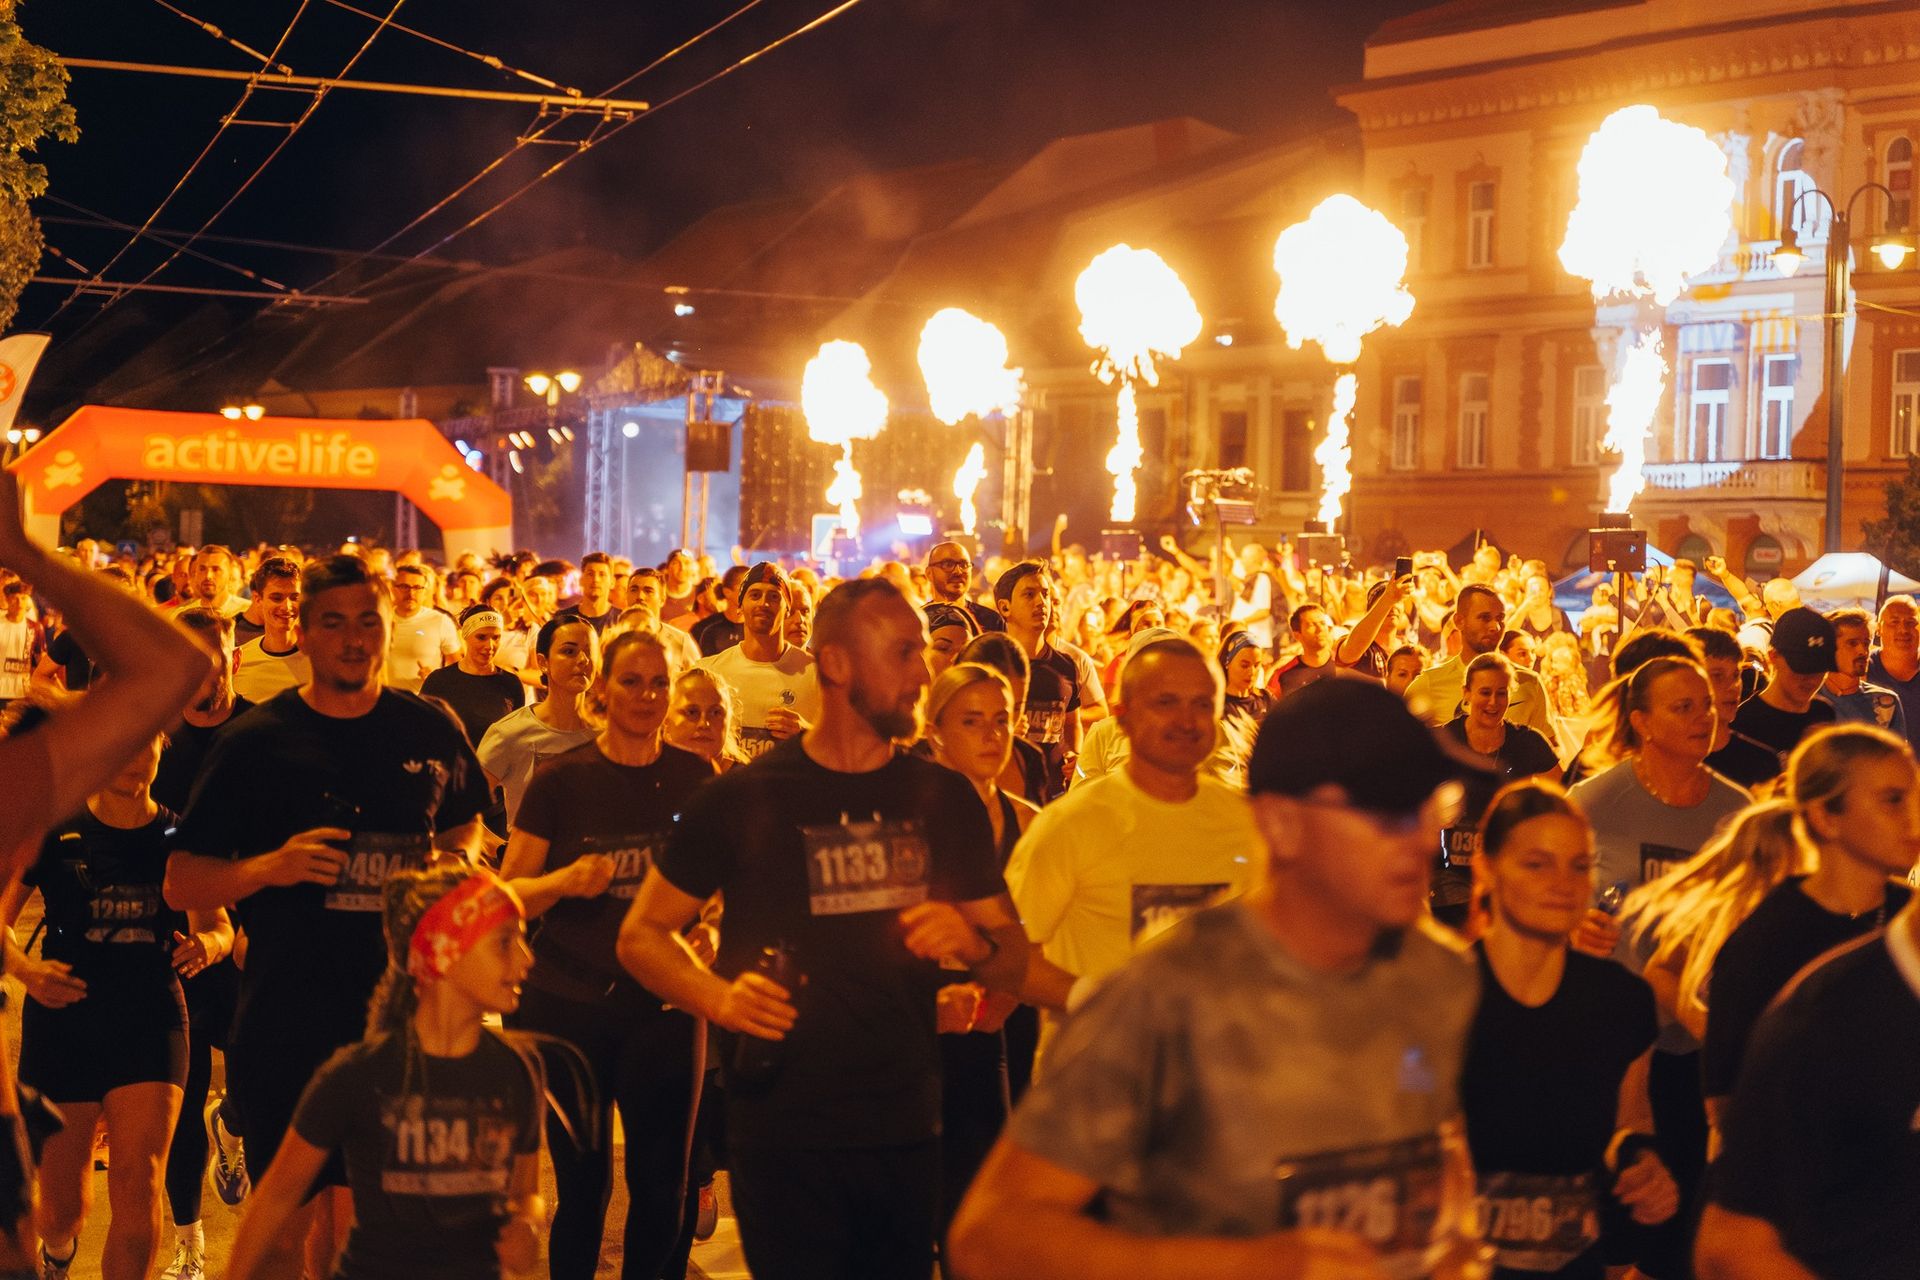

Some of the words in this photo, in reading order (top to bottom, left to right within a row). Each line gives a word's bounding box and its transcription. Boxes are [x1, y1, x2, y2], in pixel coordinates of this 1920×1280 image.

[145, 429, 375, 476] activelife
[345, 852, 403, 886] 494
[606, 846, 653, 879] 271
[815, 842, 887, 886] 1133
[90, 899, 143, 919] 1285
[398, 1118, 470, 1164] 1134
